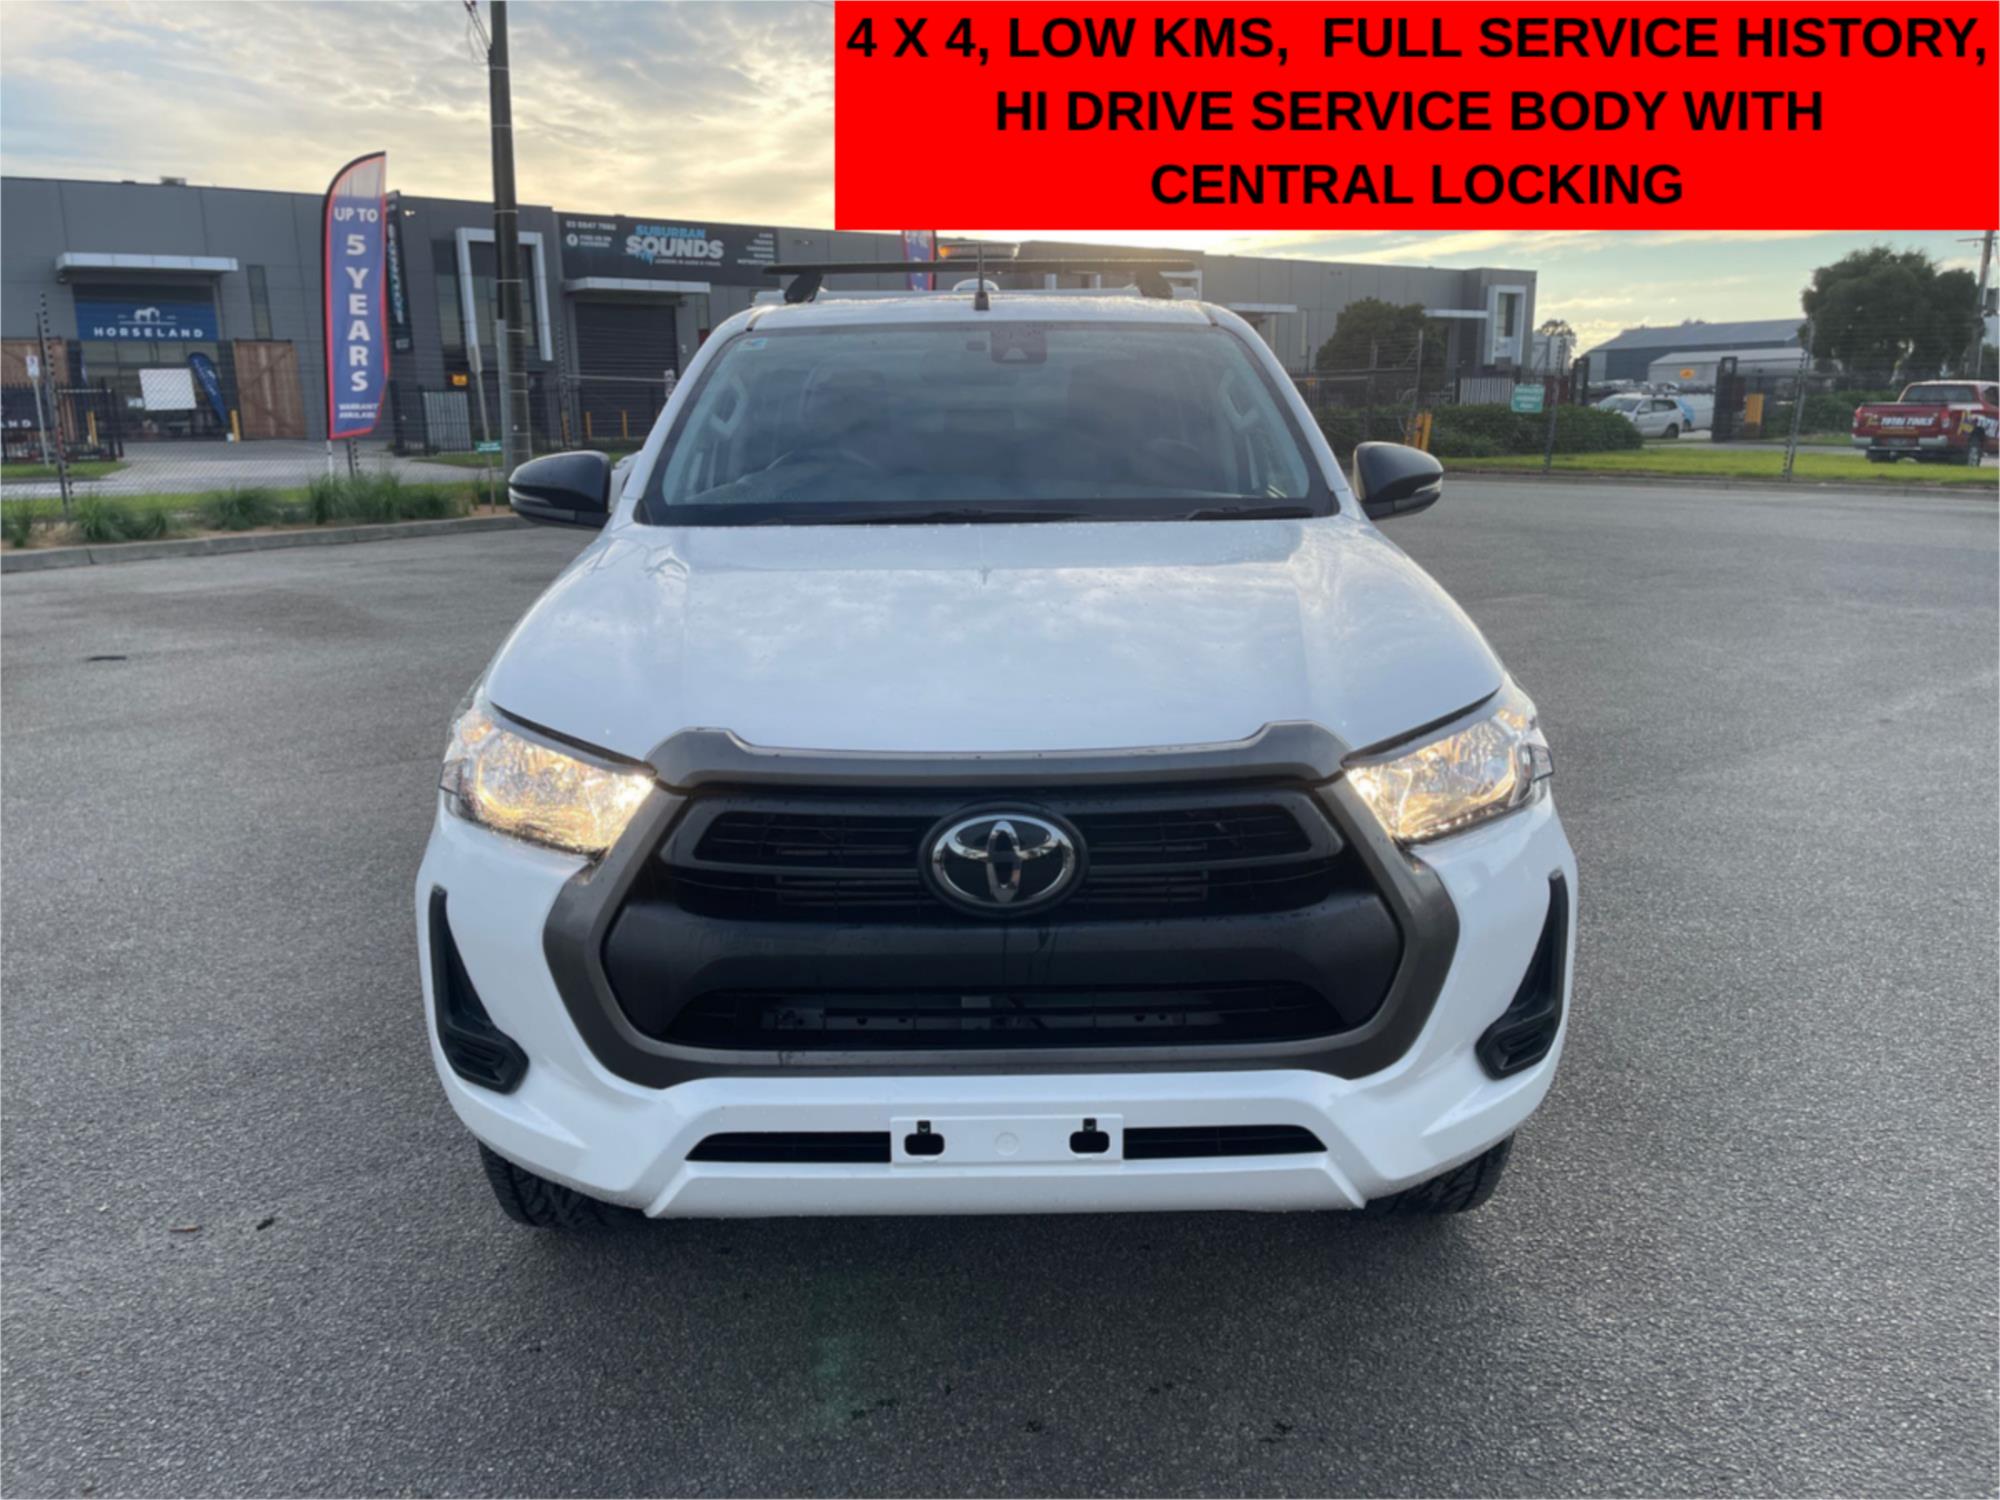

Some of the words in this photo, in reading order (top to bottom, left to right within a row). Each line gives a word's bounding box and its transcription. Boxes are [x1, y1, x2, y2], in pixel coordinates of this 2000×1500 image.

[334, 206, 354, 221] UP
[357, 207, 378, 222] TO
[636, 224, 706, 239] SUBURBAN
[346, 233, 367, 255] 5
[626, 236, 724, 259] SOUNDS
[94, 327, 203, 338] HORSELAND
[345, 267, 371, 392] YEARS
